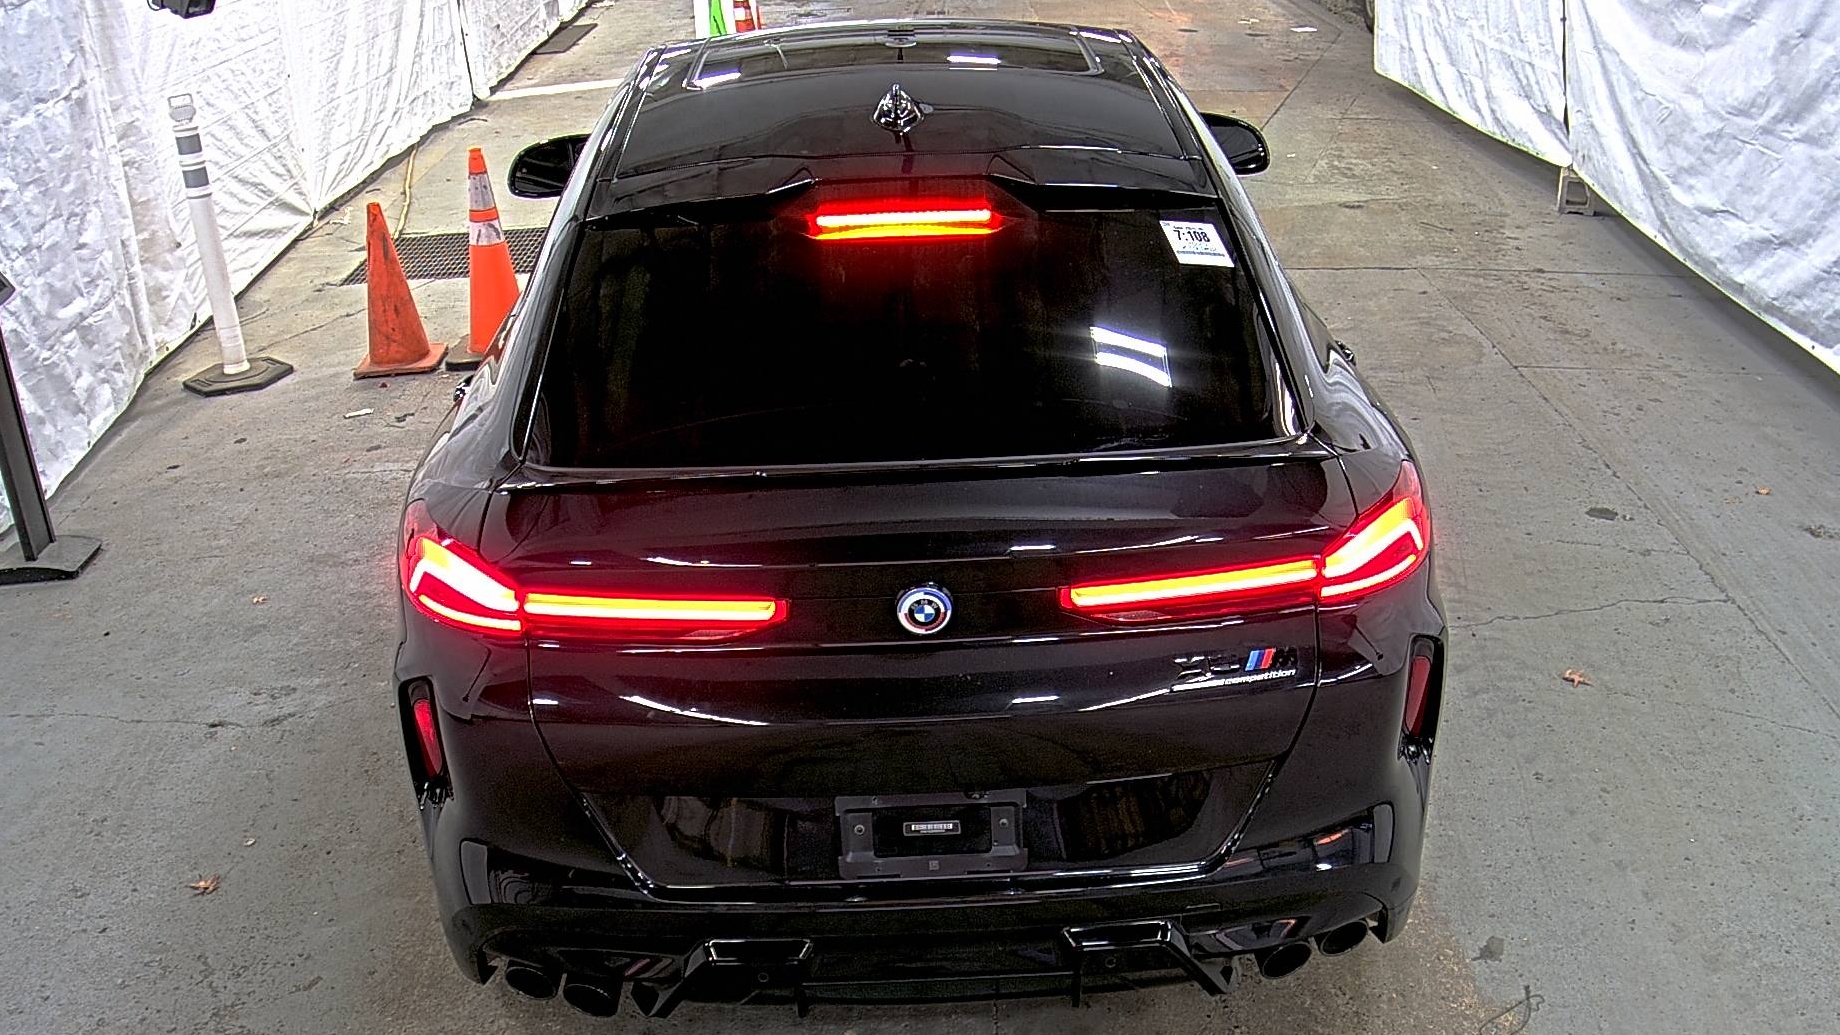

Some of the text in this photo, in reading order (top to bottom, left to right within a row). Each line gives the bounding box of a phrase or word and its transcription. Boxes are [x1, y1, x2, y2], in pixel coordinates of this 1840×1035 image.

[1173, 229, 1210, 242] 7:108
[910, 599, 939, 610] BMW
[1225, 669, 1296, 685] competition
